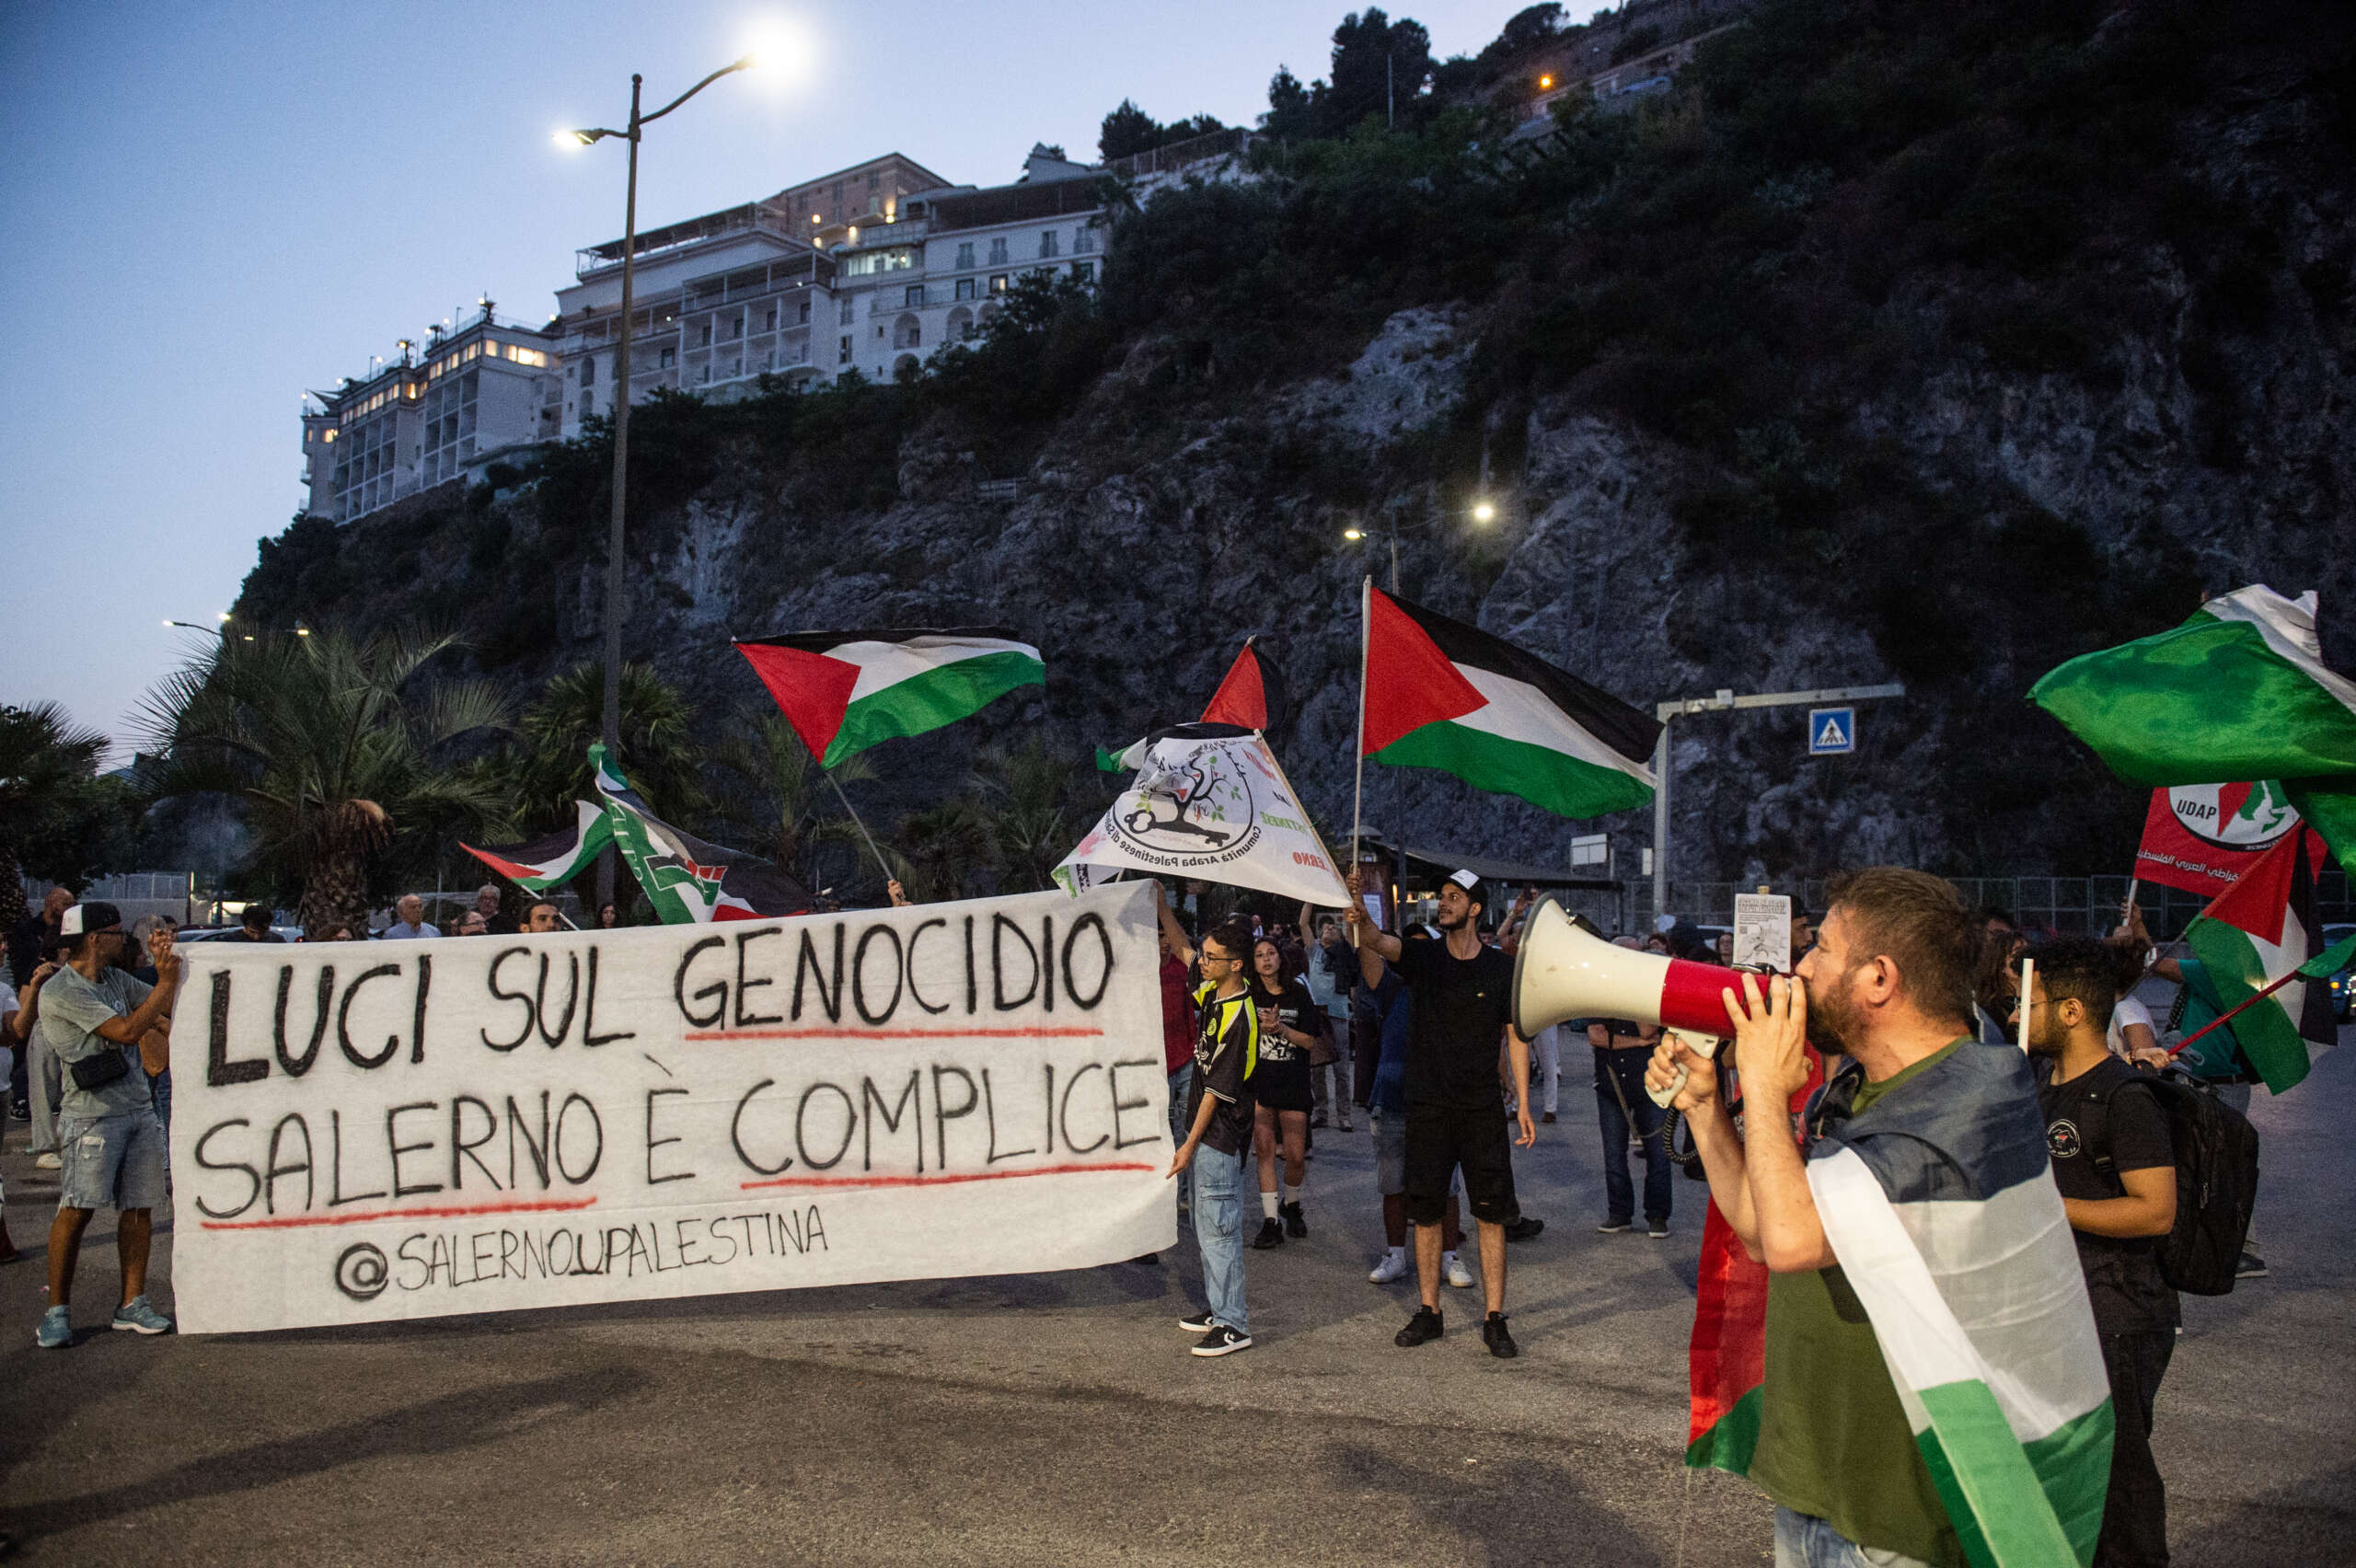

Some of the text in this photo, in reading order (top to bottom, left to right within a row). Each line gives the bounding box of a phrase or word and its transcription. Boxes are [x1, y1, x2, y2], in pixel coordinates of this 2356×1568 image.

[2177, 800, 2217, 820] UDAP
[207, 912, 1114, 1087] LUCI SUL GENOCIDIO
[195, 1052, 1162, 1219] SALERNO È COMPLICE
